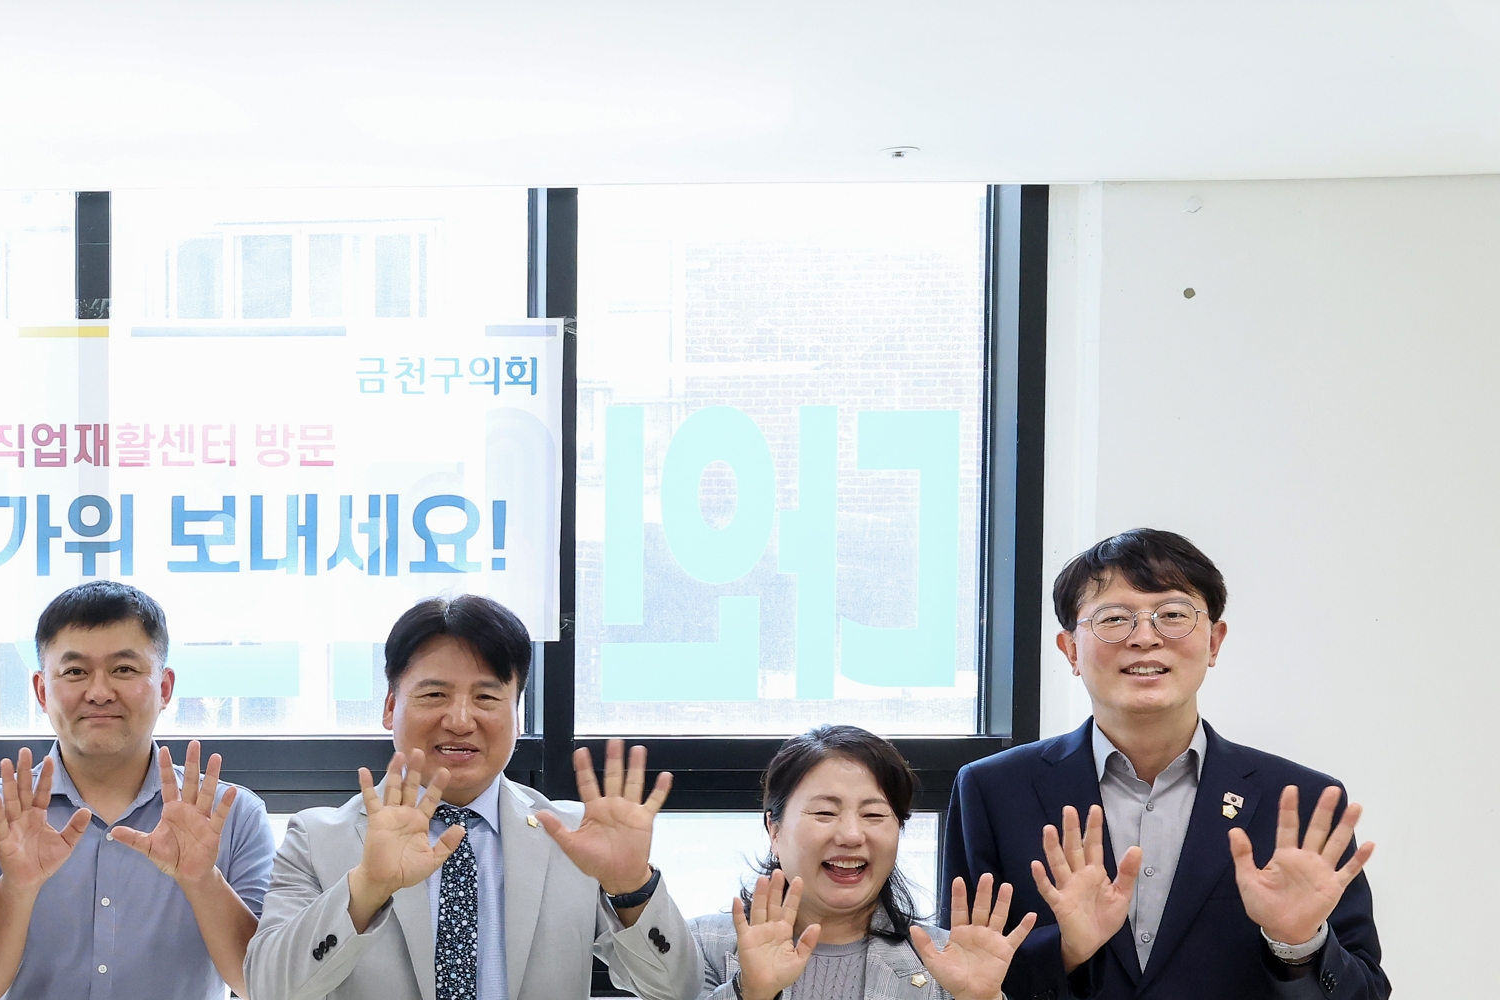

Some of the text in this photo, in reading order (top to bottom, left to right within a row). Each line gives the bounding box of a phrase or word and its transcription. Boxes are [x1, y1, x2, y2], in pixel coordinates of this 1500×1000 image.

[356, 356, 538, 396] 금천구의회
[255, 423, 336, 467] 방문
[167, 493, 507, 577] 보내세요!
